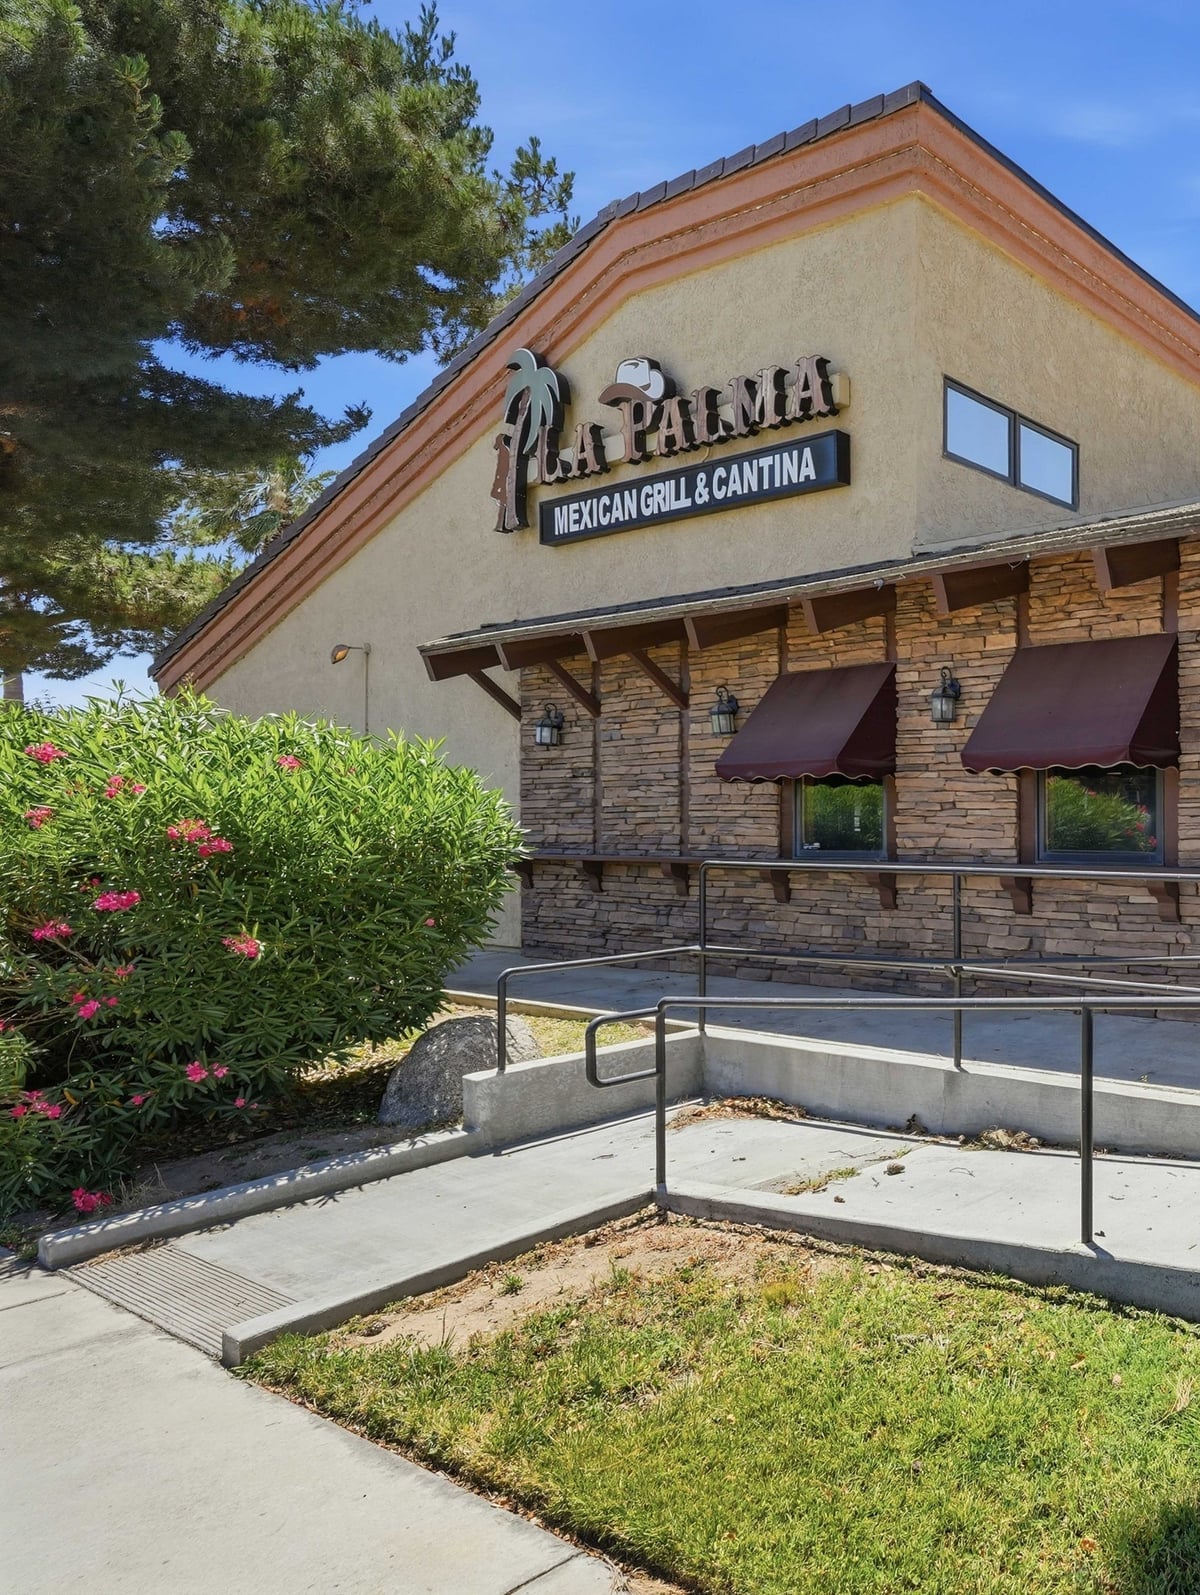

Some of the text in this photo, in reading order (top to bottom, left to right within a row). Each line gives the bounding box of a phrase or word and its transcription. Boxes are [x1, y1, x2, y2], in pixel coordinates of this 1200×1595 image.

[536, 353, 840, 486] LA PALMA
[553, 447, 817, 536] MEXICAN GRILL & CANTINA
